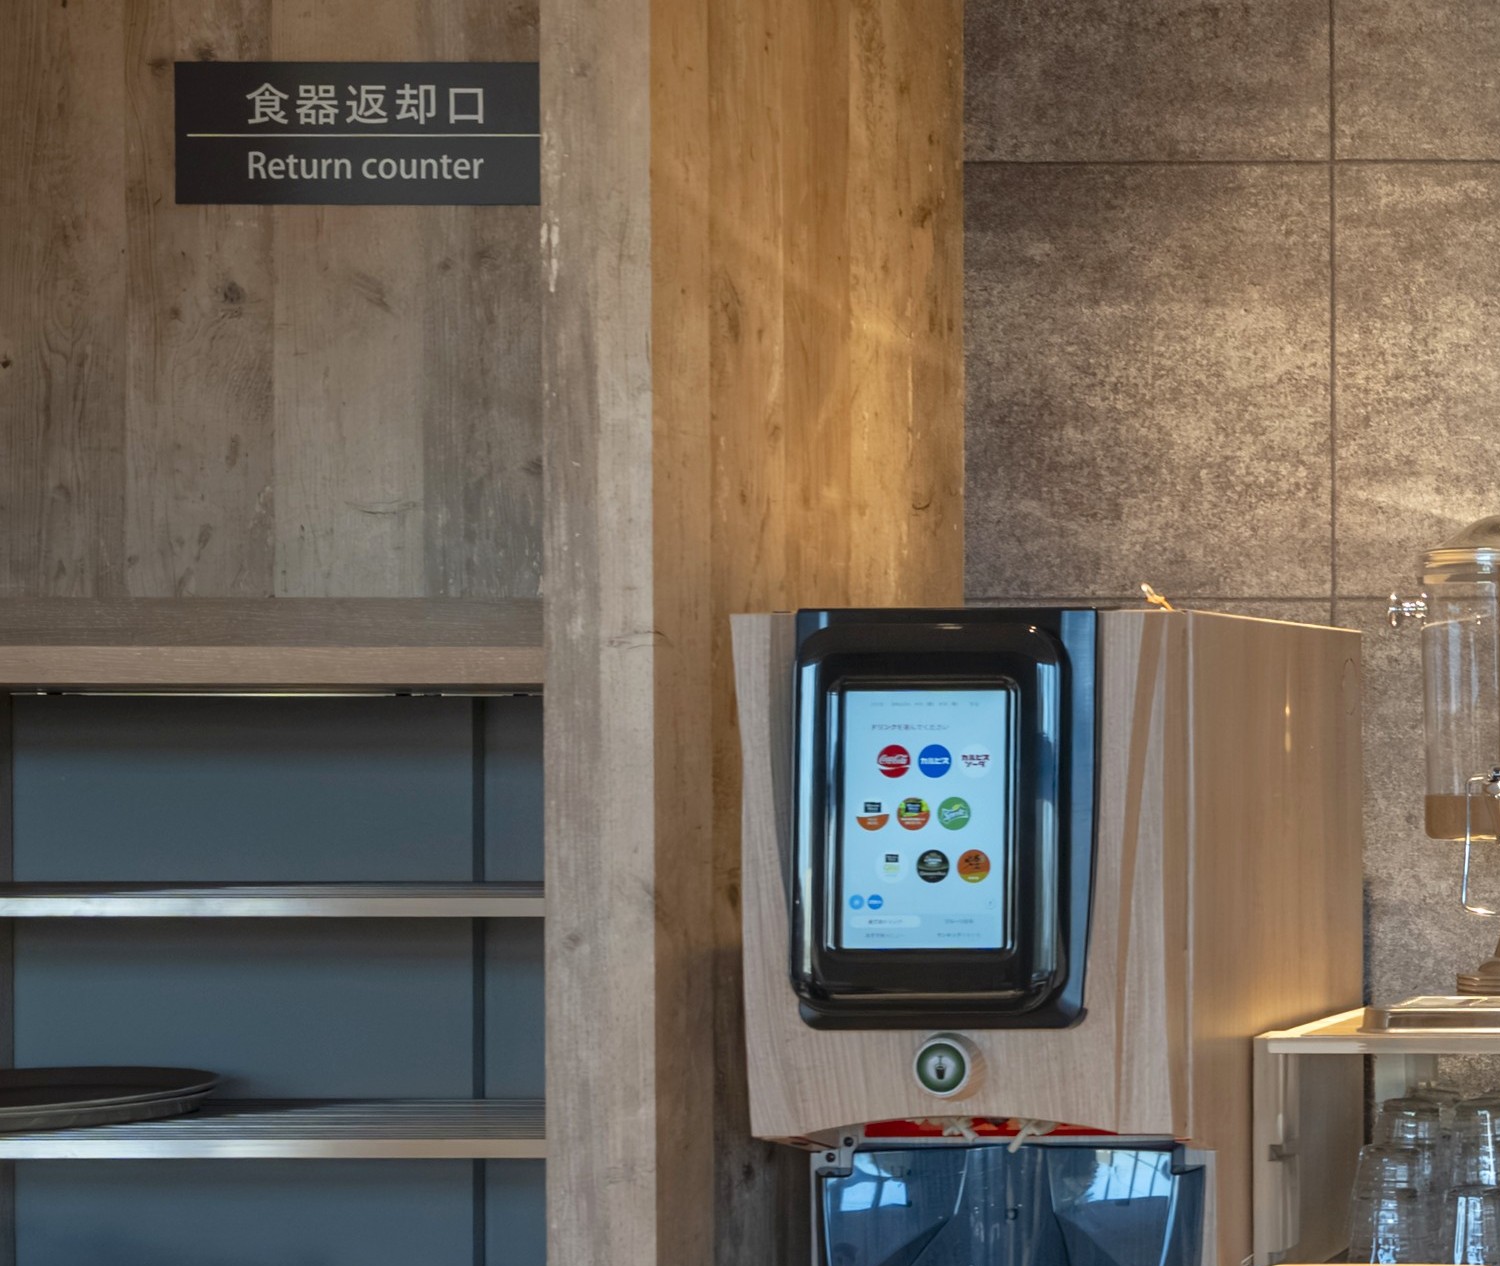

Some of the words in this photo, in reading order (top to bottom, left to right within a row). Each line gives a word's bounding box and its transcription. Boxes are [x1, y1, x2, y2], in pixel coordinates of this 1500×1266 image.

[245, 81, 486, 126] 食器返却口
[247, 150, 352, 180] Return
[361, 155, 485, 180] counter
